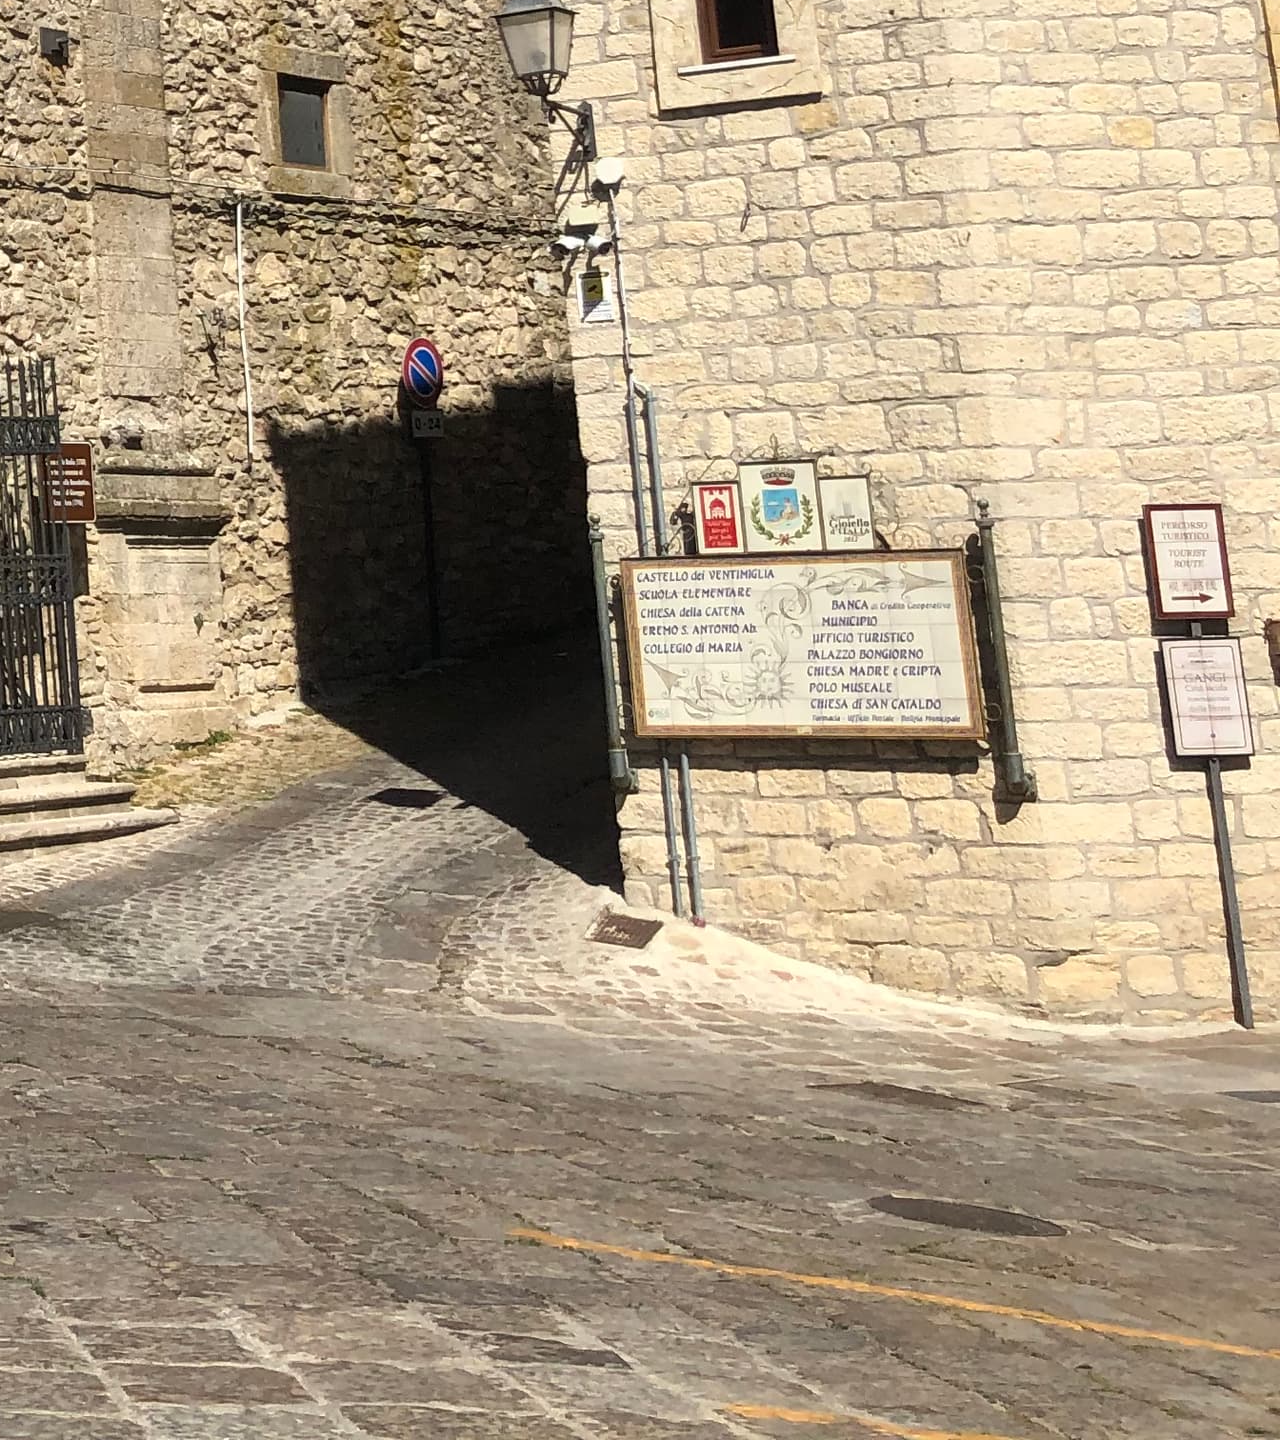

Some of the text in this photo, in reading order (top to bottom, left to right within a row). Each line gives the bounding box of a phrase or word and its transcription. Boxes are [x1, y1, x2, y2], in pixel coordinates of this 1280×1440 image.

[1161, 521, 1208, 530] PERCORSO
[1161, 531, 1210, 541] TURISTICO
[1168, 548, 1208, 558] TOURIST
[637, 569, 775, 583] CASTELLO dei VENTIMIGLIA
[639, 587, 752, 600] SCUOLA ELEMENTARE
[831, 600, 869, 610] BANCA
[640, 606, 745, 619] CHIESA della CATENA
[822, 616, 878, 627] MUNICIPIO
[643, 625, 679, 636] EREMO
[692, 624, 739, 635] ANTONIO
[812, 631, 914, 644] UFFICIO TURISTICO
[644, 642, 743, 655] COLLEGIO di MARIA
[807, 648, 924, 660] PALAZZO BONGIORNO
[807, 665, 941, 677] CHIESA MADRE e CRIPTA
[1183, 672, 1226, 683] GANGI
[809, 682, 893, 693] POLO MUSEALE
[810, 698, 941, 709] CHIESA di SAN CATALDO
